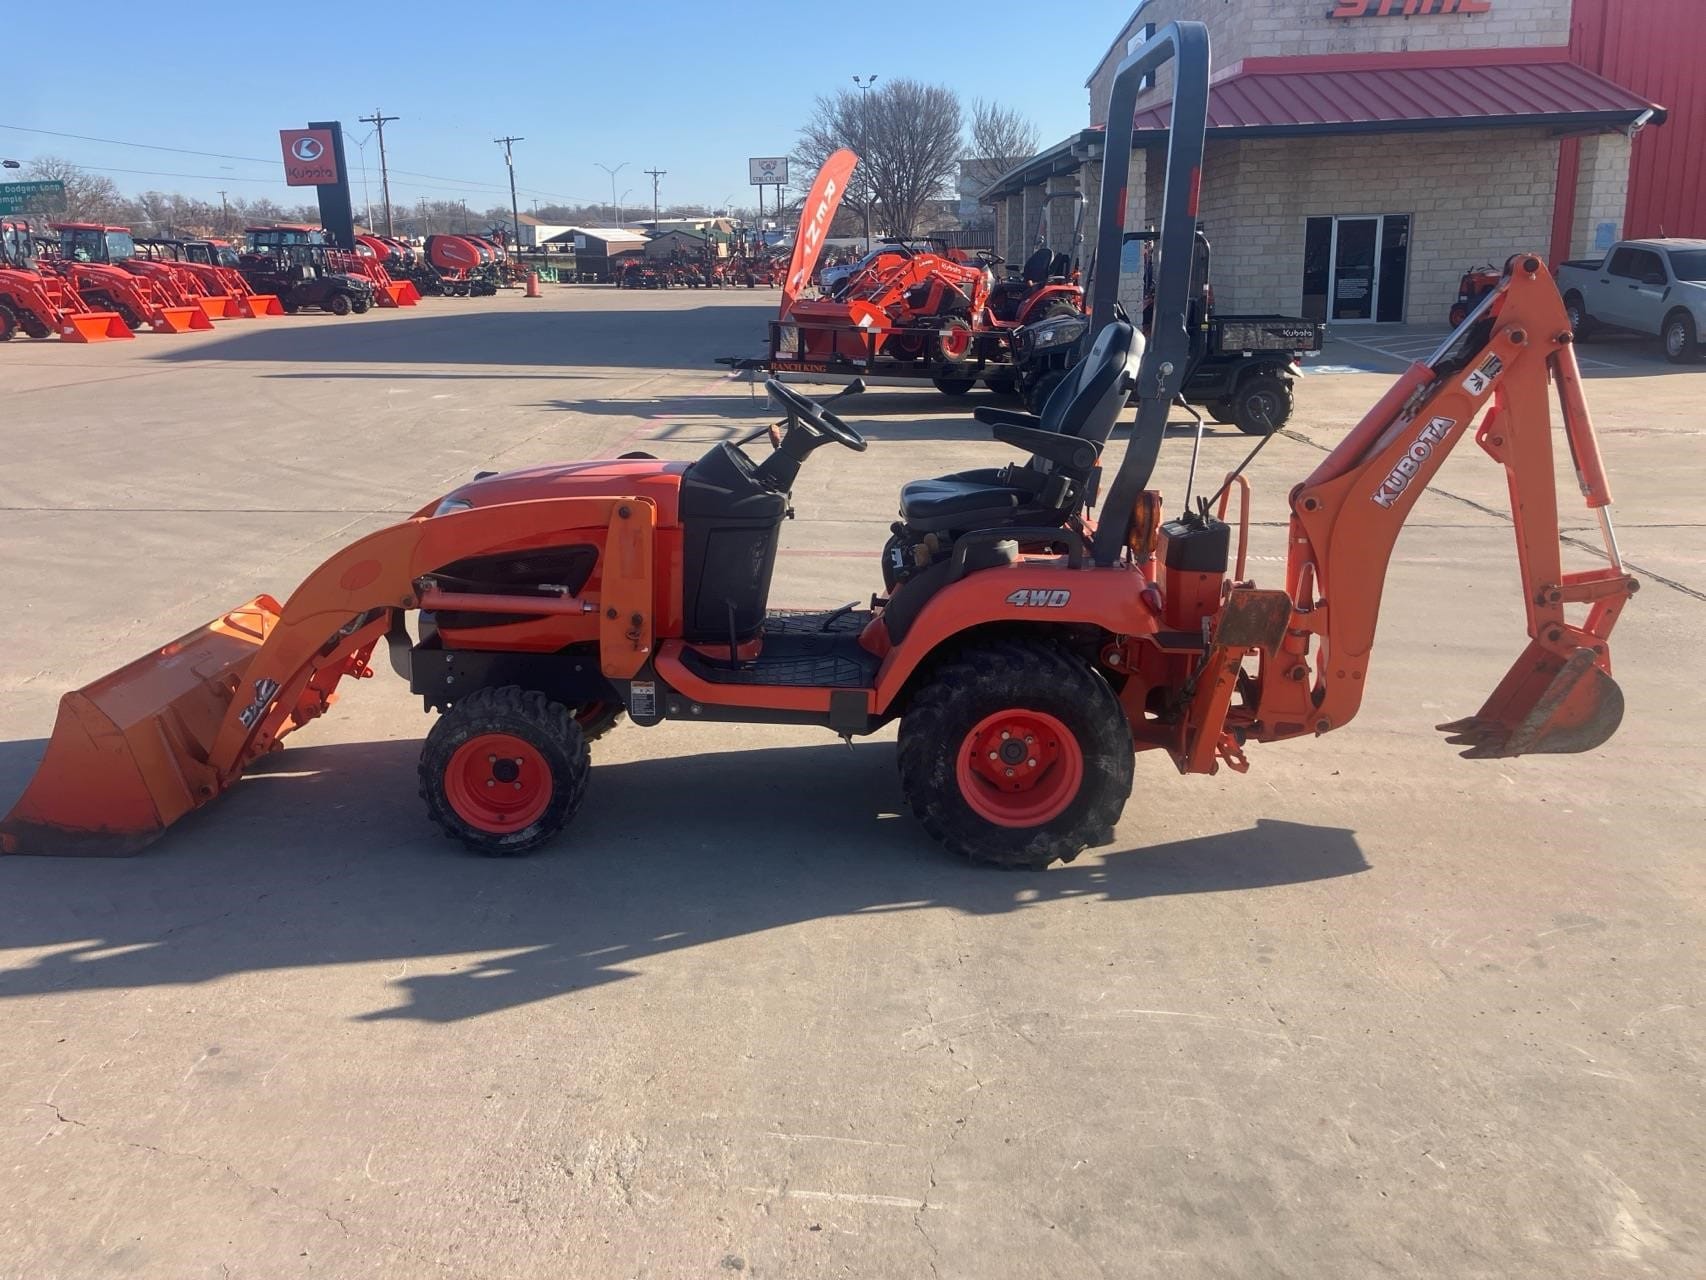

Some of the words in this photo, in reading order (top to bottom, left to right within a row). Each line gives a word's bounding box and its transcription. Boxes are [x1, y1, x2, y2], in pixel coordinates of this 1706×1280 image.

[288, 167, 334, 179] Kubota
[1282, 328, 1312, 337] Kubota
[770, 362, 801, 370] RANCH
[803, 363, 827, 372] KING
[1371, 416, 1457, 509] KUBOTA
[1005, 588, 1072, 608] 4WD
